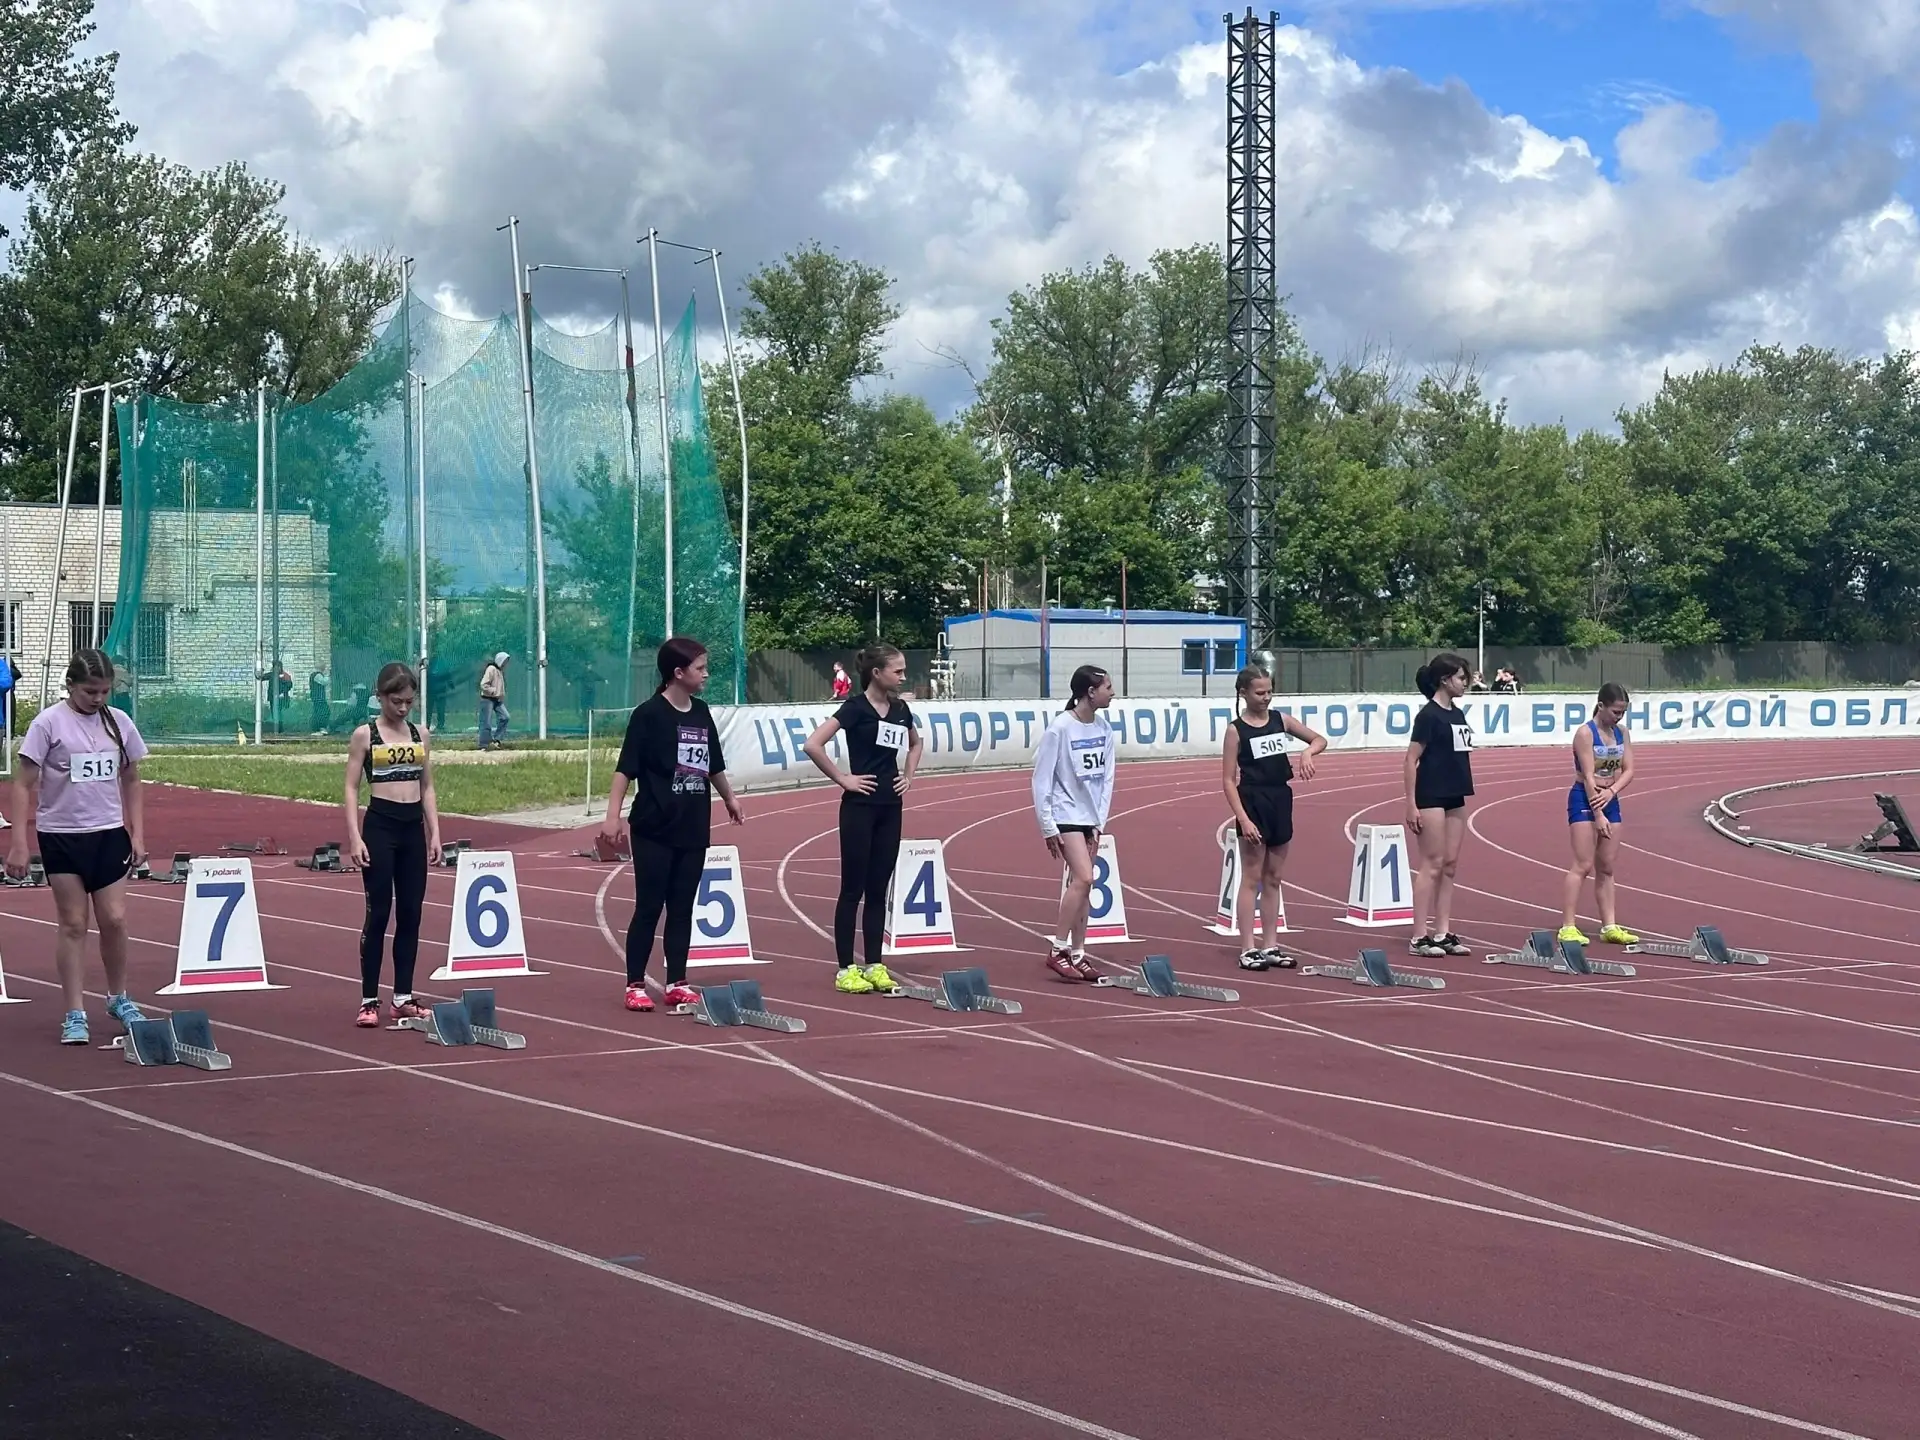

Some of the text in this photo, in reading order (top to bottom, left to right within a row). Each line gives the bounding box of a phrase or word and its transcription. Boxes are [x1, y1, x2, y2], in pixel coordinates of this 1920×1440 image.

[1531, 694, 1787, 733] БРНСКОЙ
[1811, 698, 1920, 727] ОБЛ
[884, 729, 904, 747] 511
[1260, 738, 1284, 755] 505
[388, 747, 416, 765] 323
[686, 746, 709, 767] 194
[1083, 752, 1105, 770] 514
[82, 759, 114, 778] 513
[477, 860, 506, 870] polanik
[707, 854, 732, 863] polanik
[211, 867, 242, 878] polanik
[1221, 848, 1236, 911] 2
[1380, 843, 1401, 903] 1
[695, 867, 736, 939] 5
[903, 860, 943, 928] 4
[196, 881, 246, 962] 7
[465, 874, 510, 949] 6
